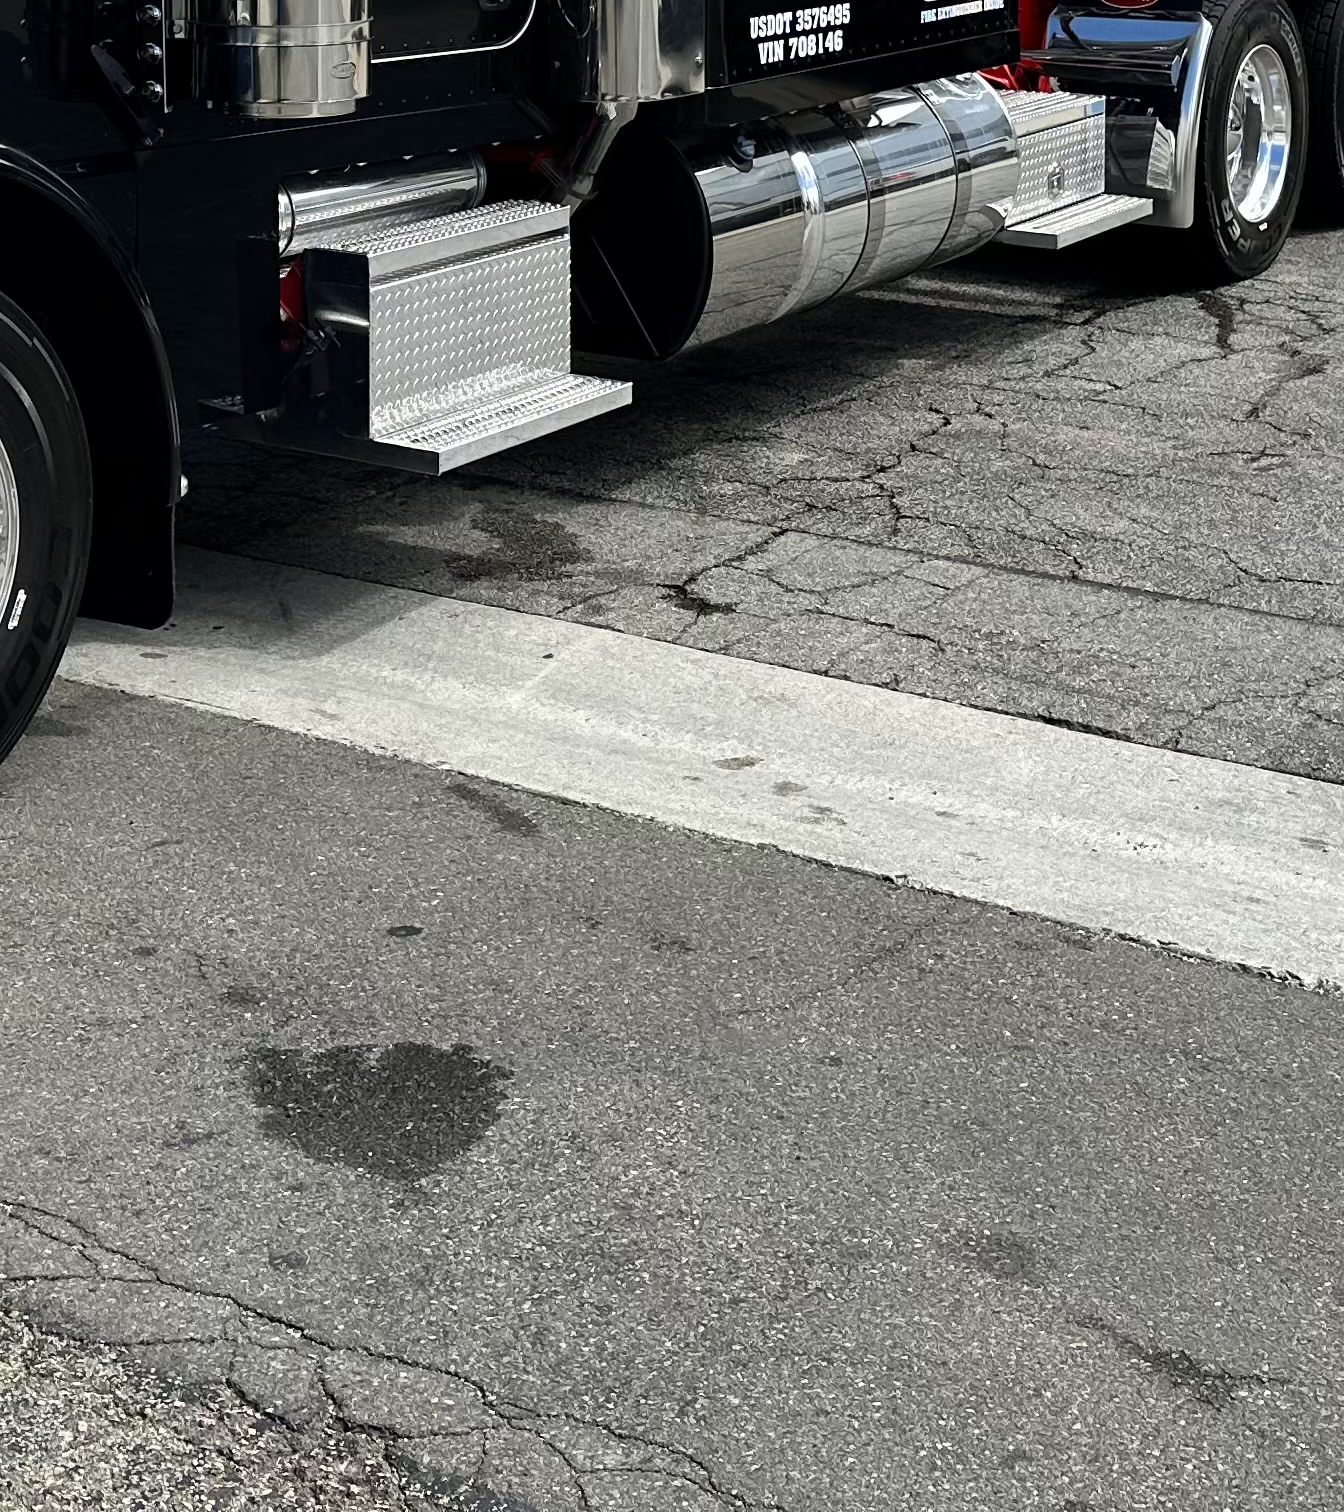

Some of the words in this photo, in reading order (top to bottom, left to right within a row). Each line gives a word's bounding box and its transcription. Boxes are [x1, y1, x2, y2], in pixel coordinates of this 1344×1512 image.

[750, 11, 793, 40] USDOT
[795, 2, 851, 32] 3576495
[758, 39, 785, 65] VIN
[788, 29, 844, 60] 708146
